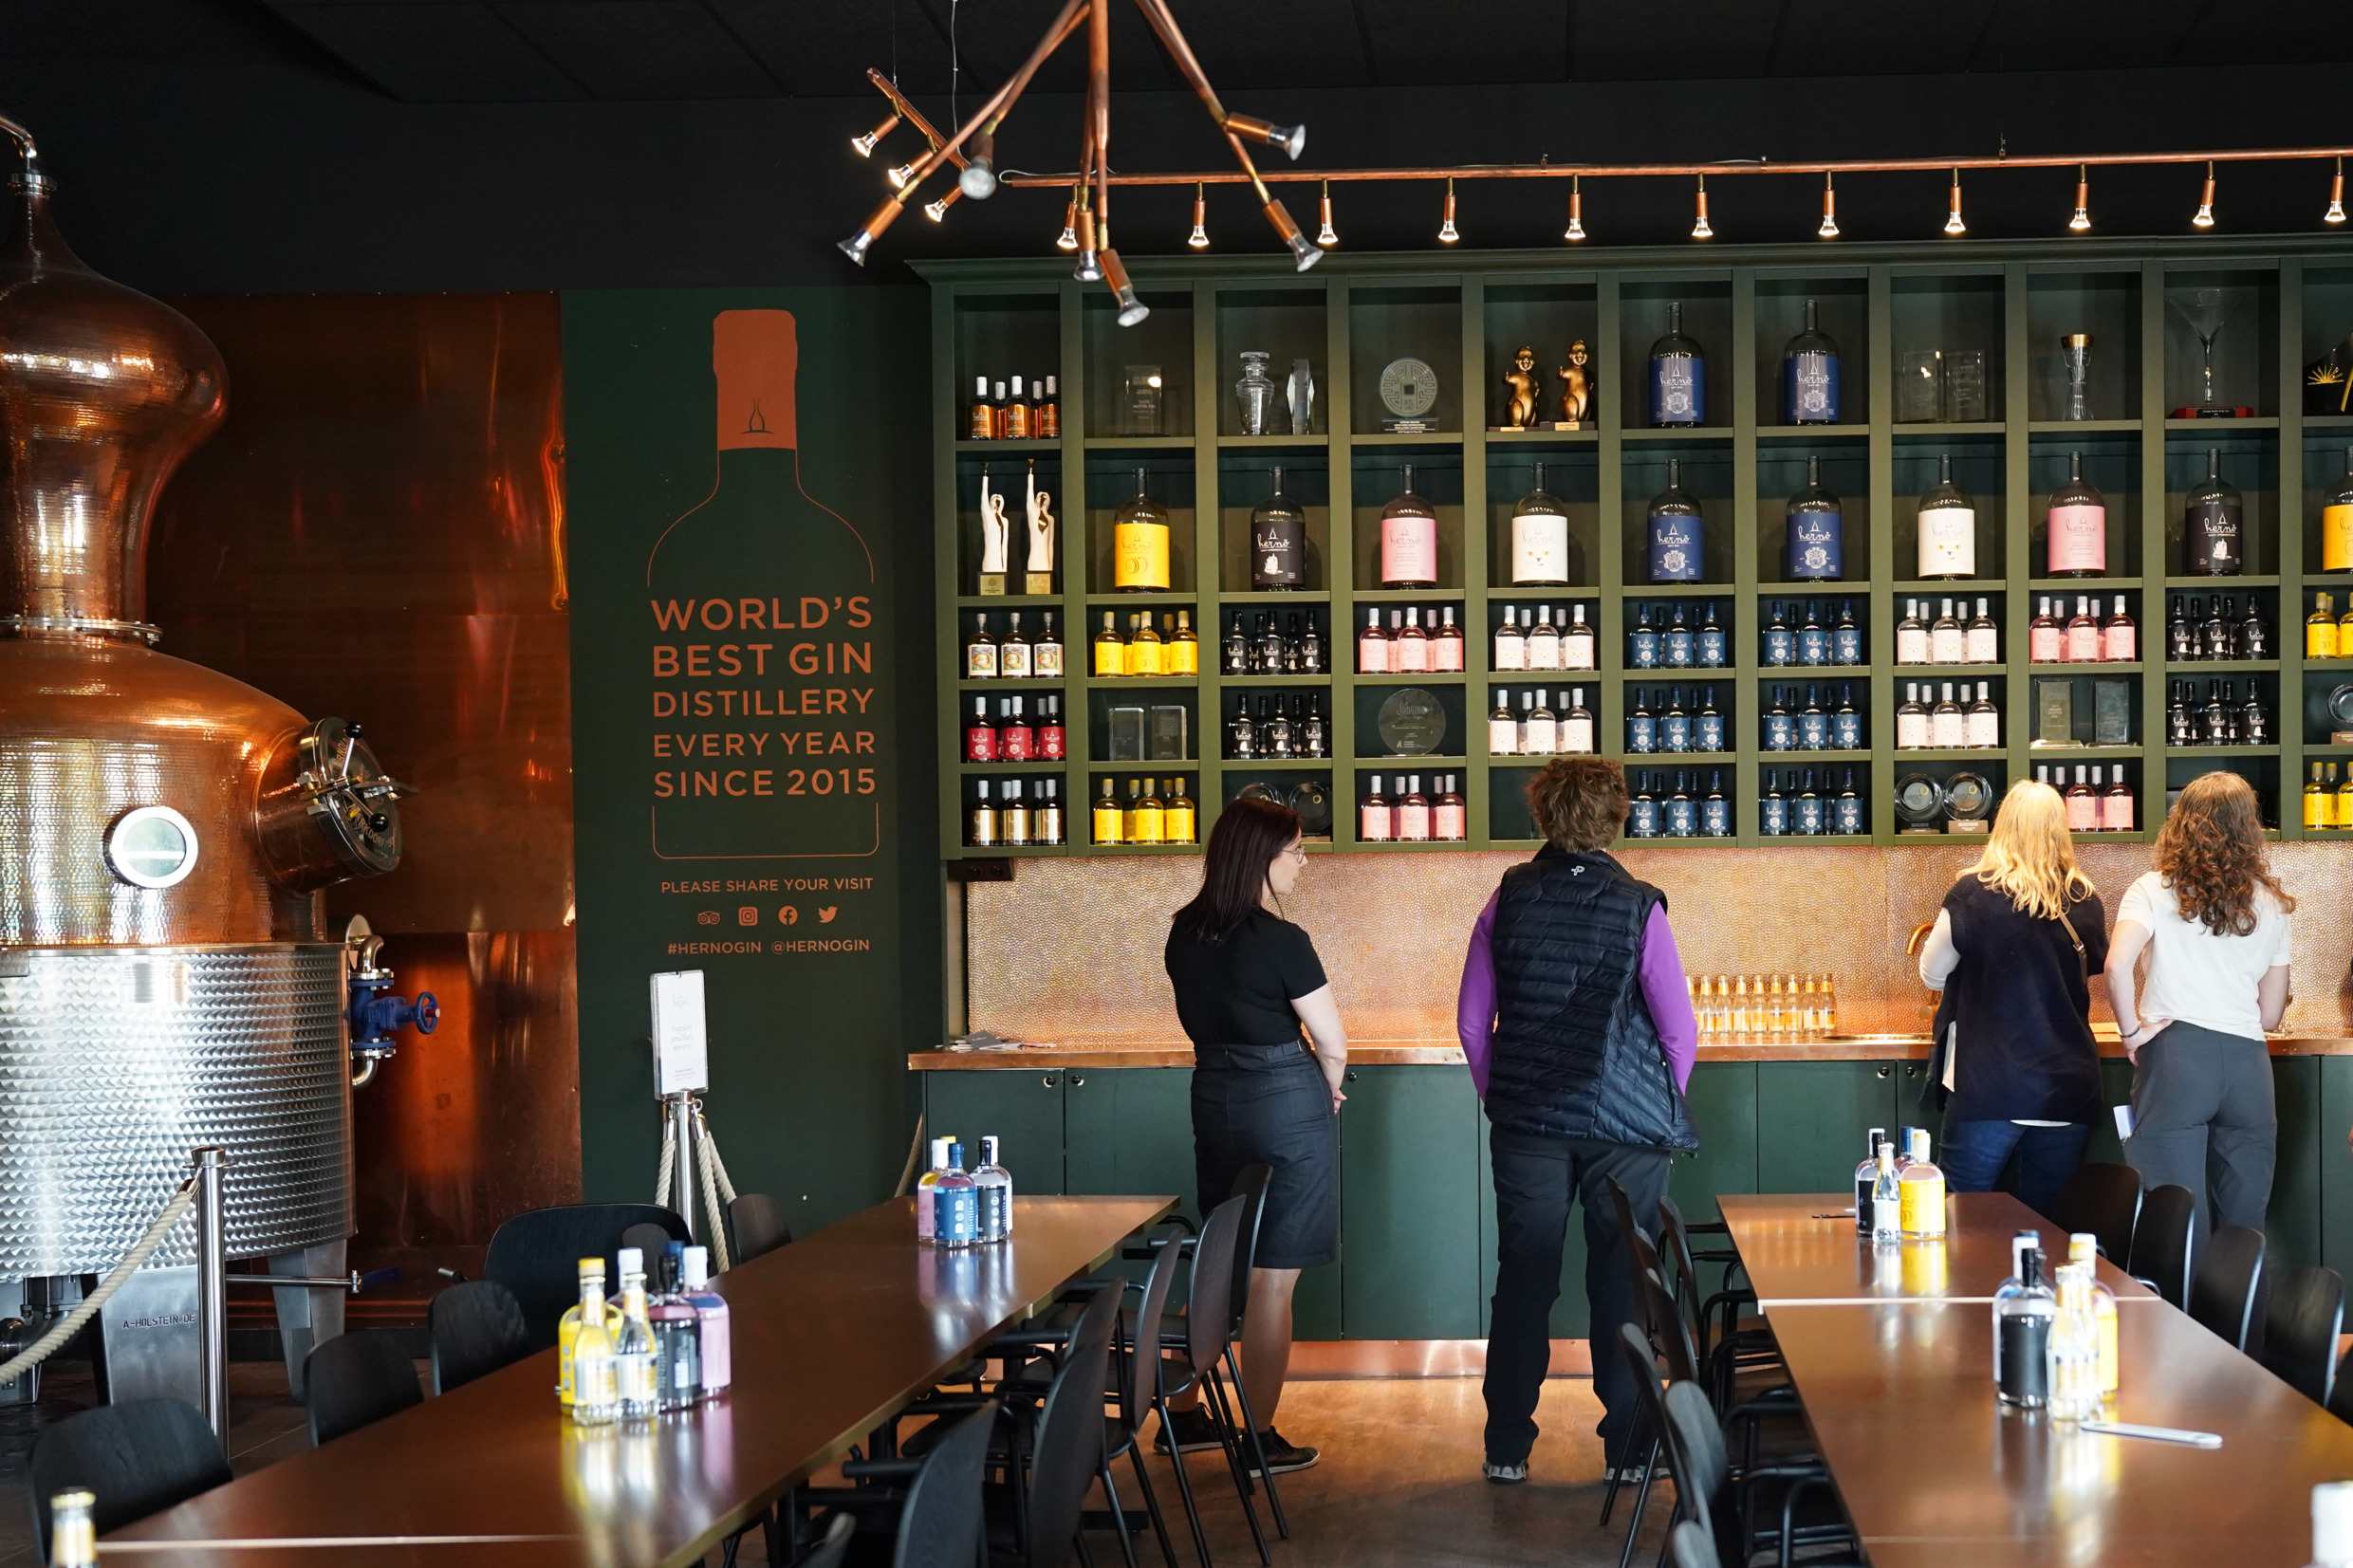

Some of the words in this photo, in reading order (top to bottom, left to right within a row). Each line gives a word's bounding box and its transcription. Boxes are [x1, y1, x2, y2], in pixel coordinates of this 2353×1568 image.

[654, 644, 773, 679] BEST
[789, 642, 871, 675] GIN
[654, 689, 874, 717] DISTILLERY
[654, 733, 769, 757] EVERY
[780, 731, 875, 755] YEAR
[655, 769, 773, 797] SINCE
[786, 768, 875, 796] 2015
[661, 880, 720, 893] PLEASE
[727, 879, 778, 892] SHARE
[784, 878, 828, 890] YOUR
[834, 878, 873, 890] VISIT
[667, 941, 762, 953] #HERNOGIN
[771, 940, 870, 954] @HERNOGIN
